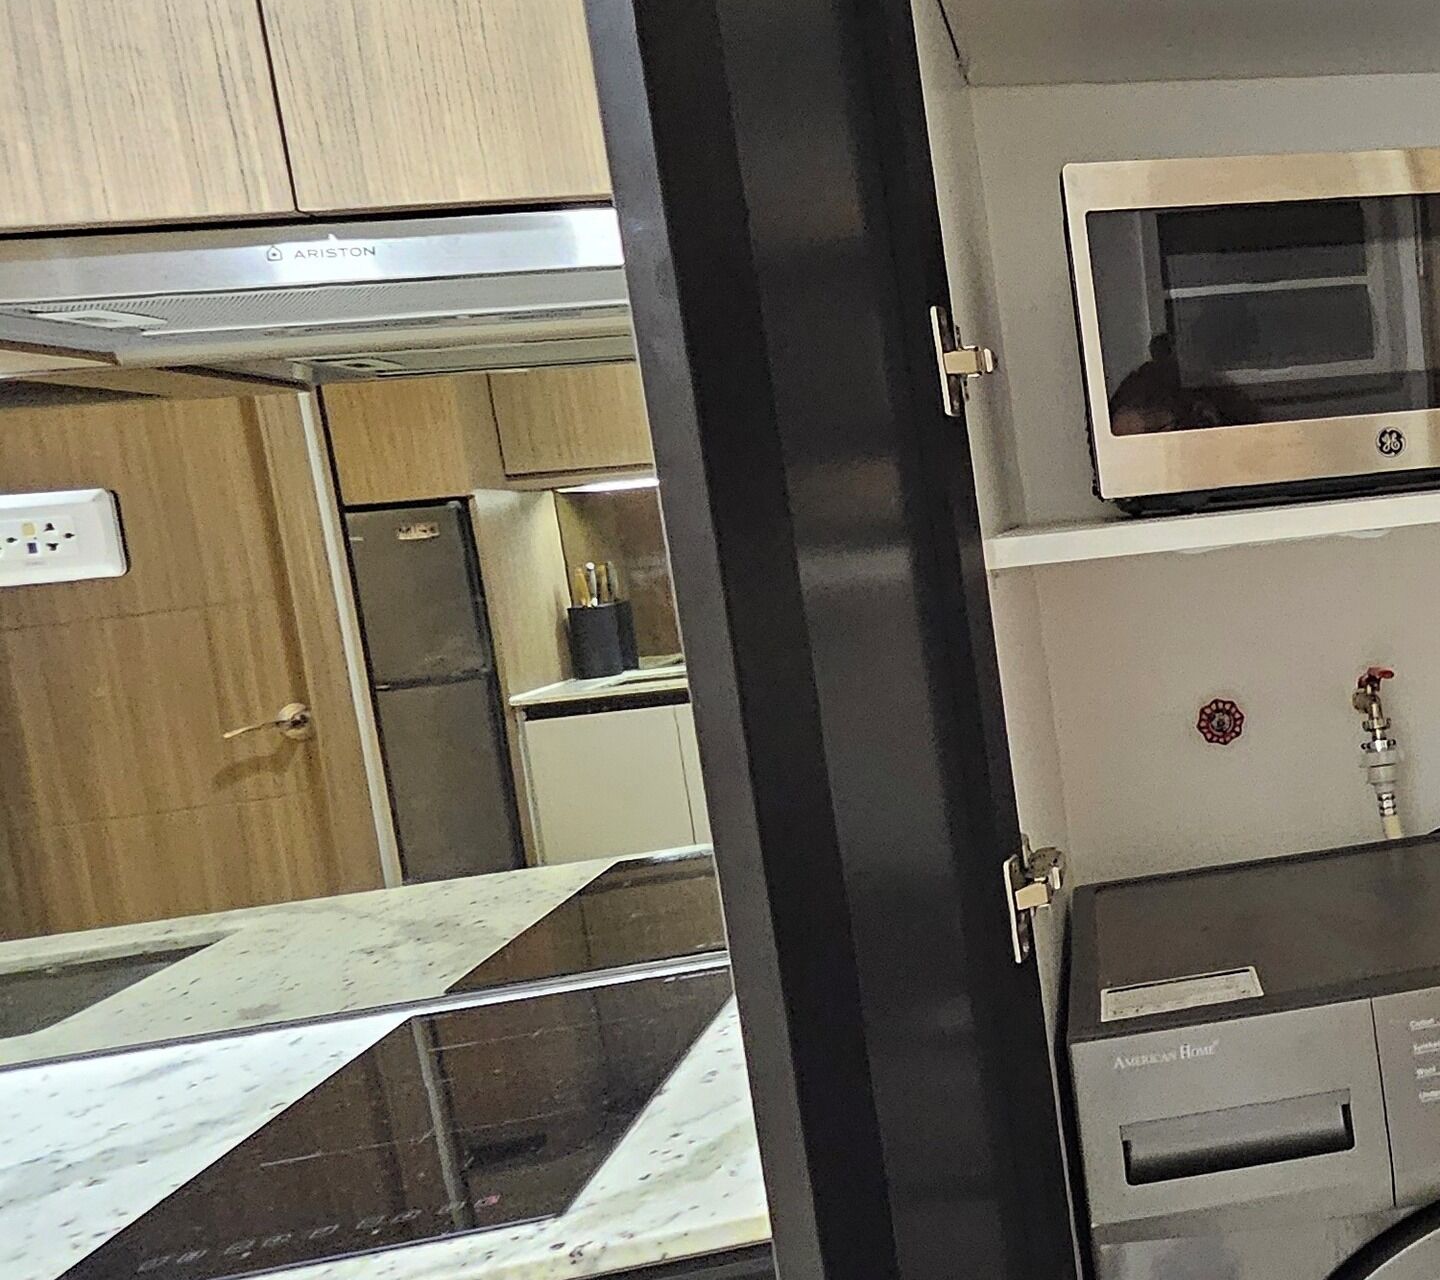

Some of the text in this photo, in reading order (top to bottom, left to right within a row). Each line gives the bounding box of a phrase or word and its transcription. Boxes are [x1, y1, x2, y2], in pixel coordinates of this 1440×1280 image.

[294, 246, 376, 259] ARISTON
[1114, 1043, 1215, 1070] AMERICAN HOME
